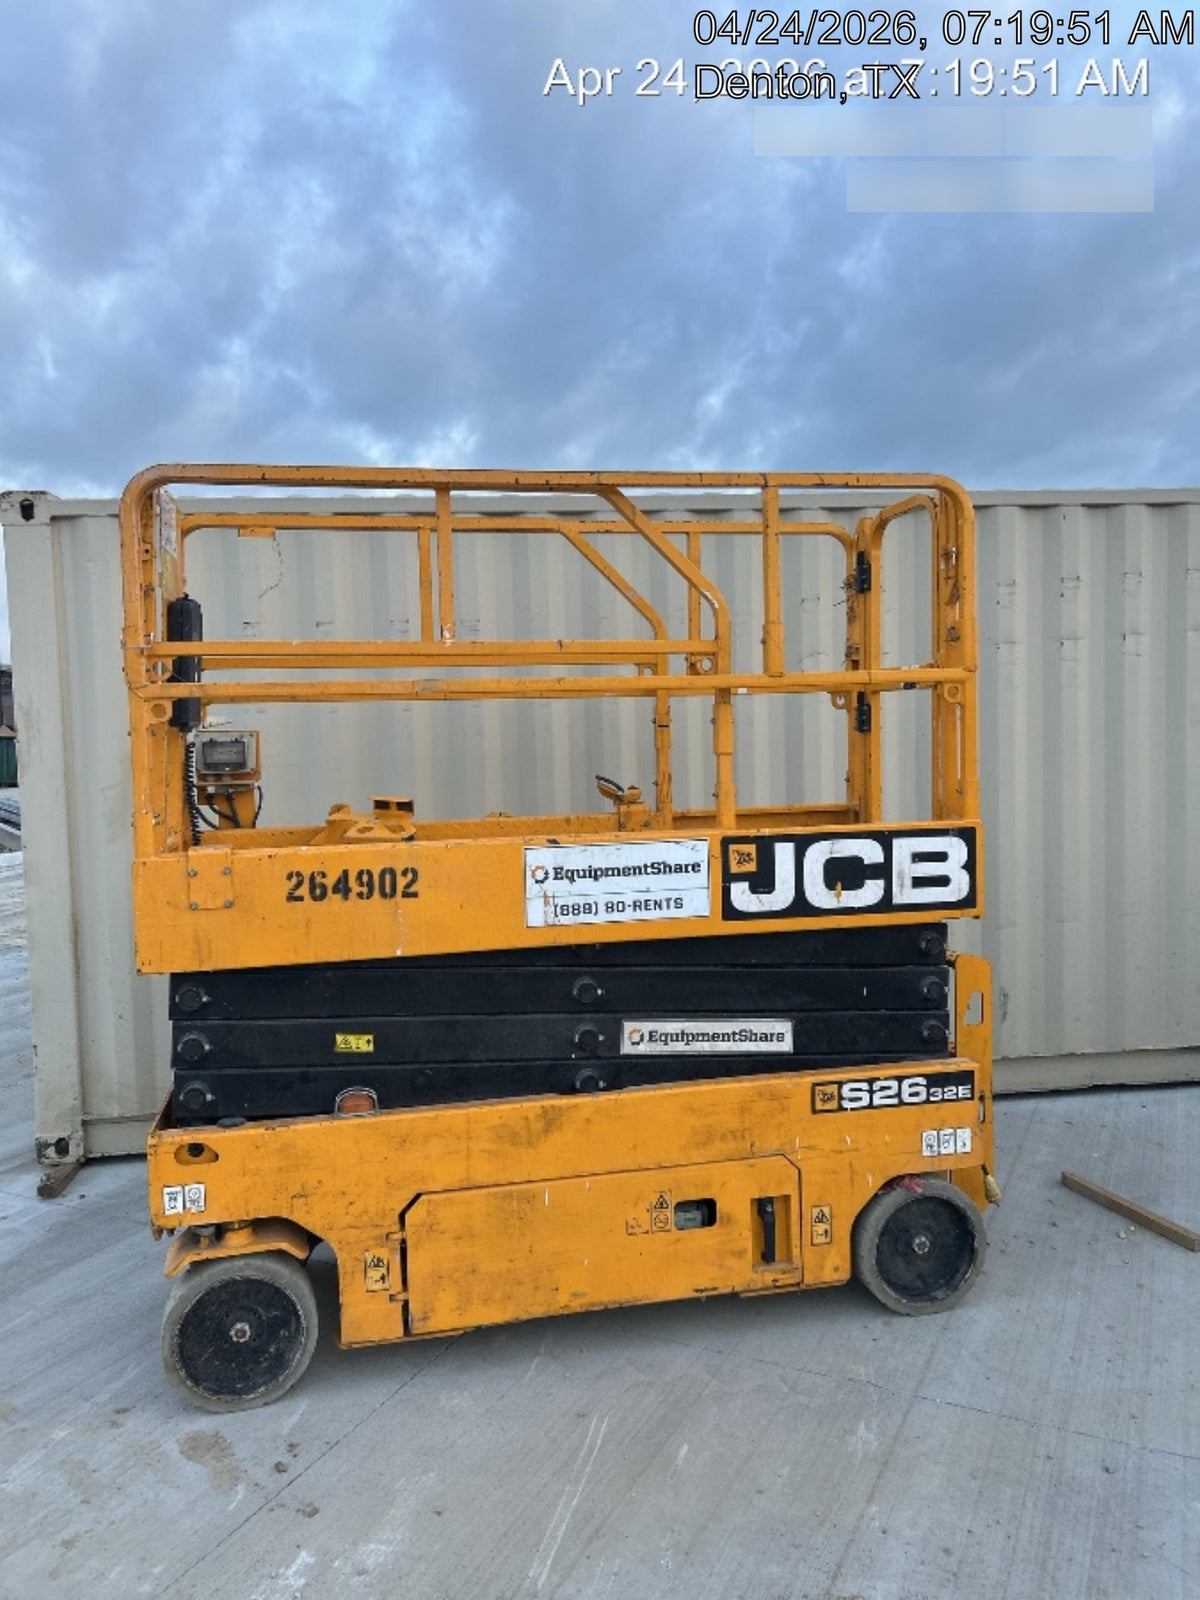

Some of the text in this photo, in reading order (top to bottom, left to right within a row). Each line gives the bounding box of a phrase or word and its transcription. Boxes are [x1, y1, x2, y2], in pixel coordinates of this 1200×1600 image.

[285, 866, 420, 903] 264902
[552, 860, 702, 885] EquipmentShare
[729, 836, 971, 912] JCB
[553, 897, 684, 918] (888) 80-RENTS
[647, 1029, 785, 1046] EquipmentShare
